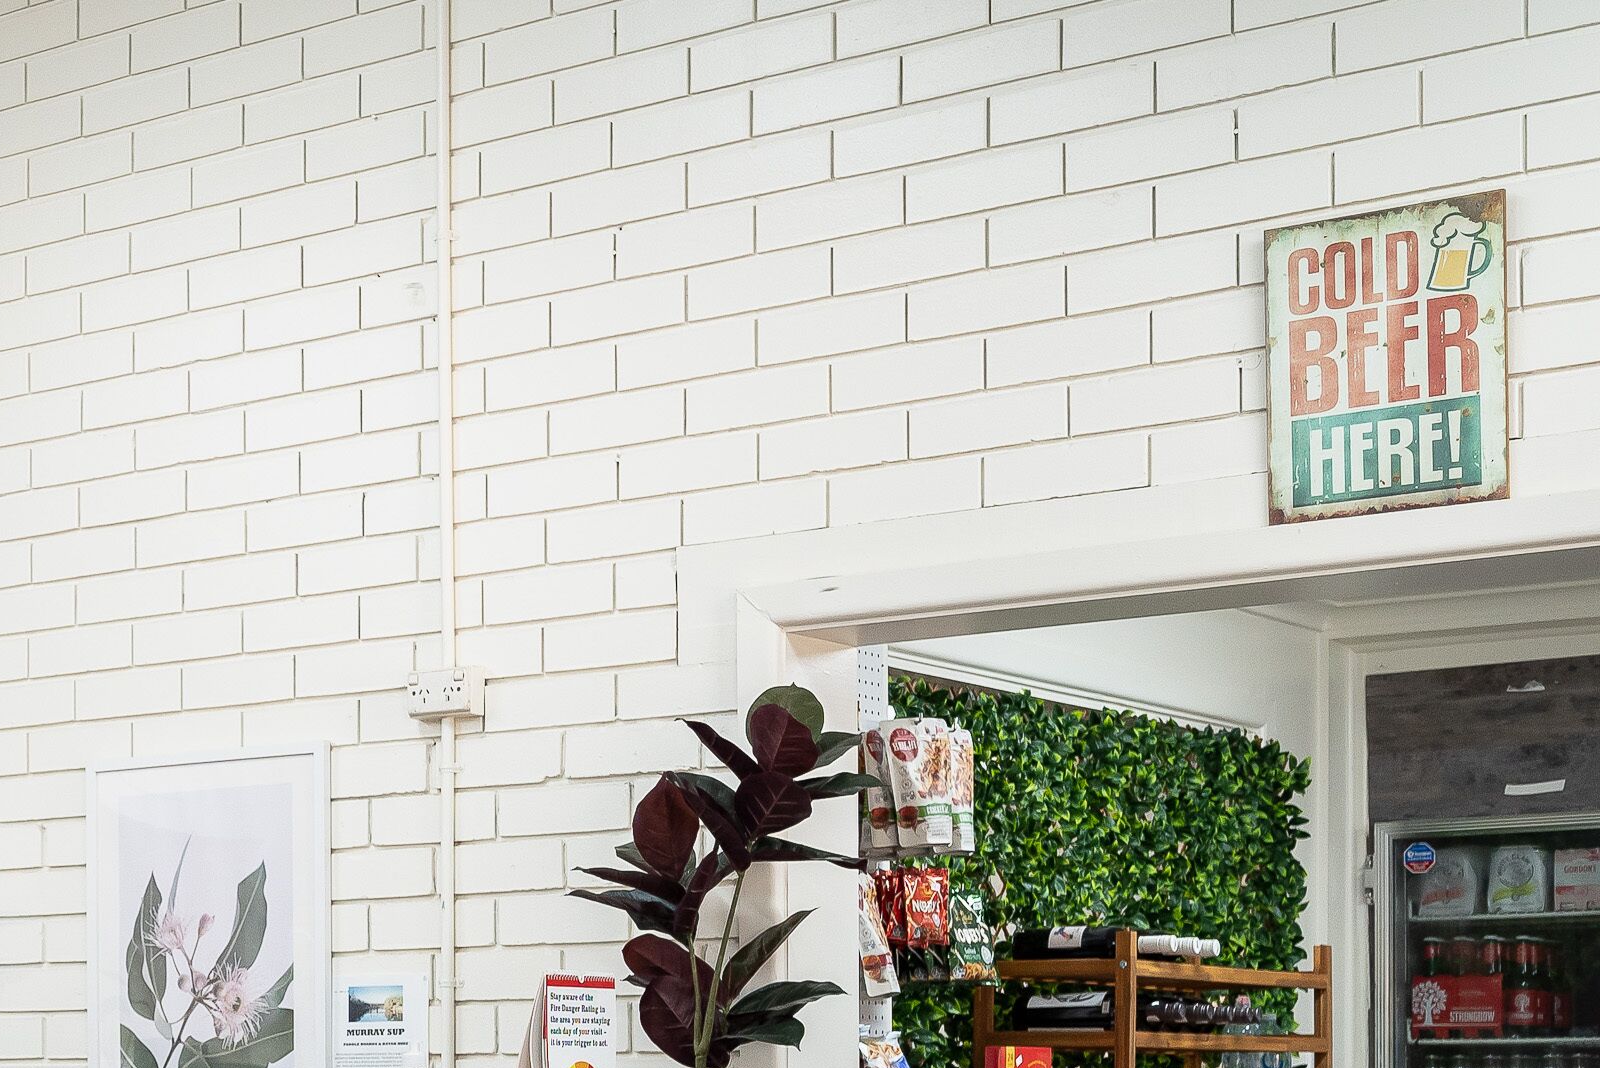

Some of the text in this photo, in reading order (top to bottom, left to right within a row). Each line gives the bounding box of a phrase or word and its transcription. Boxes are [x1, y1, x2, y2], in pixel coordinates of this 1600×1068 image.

[1288, 230, 1418, 316] COLD
[1288, 293, 1480, 417] BEER
[1309, 409, 1462, 498] HERE!
[550, 992, 561, 1002] Stay
[578, 993, 585, 1001] of
[550, 1004, 560, 1012] Fire
[561, 1004, 580, 1013] Danger
[581, 1004, 598, 1014] Rating
[590, 1018, 610, 1026] staying
[346, 1028, 405, 1037] MURRAY SUP
[563, 1027, 571, 1036] day
[572, 1027, 578, 1035] of
[574, 1039, 591, 1048] trigger
